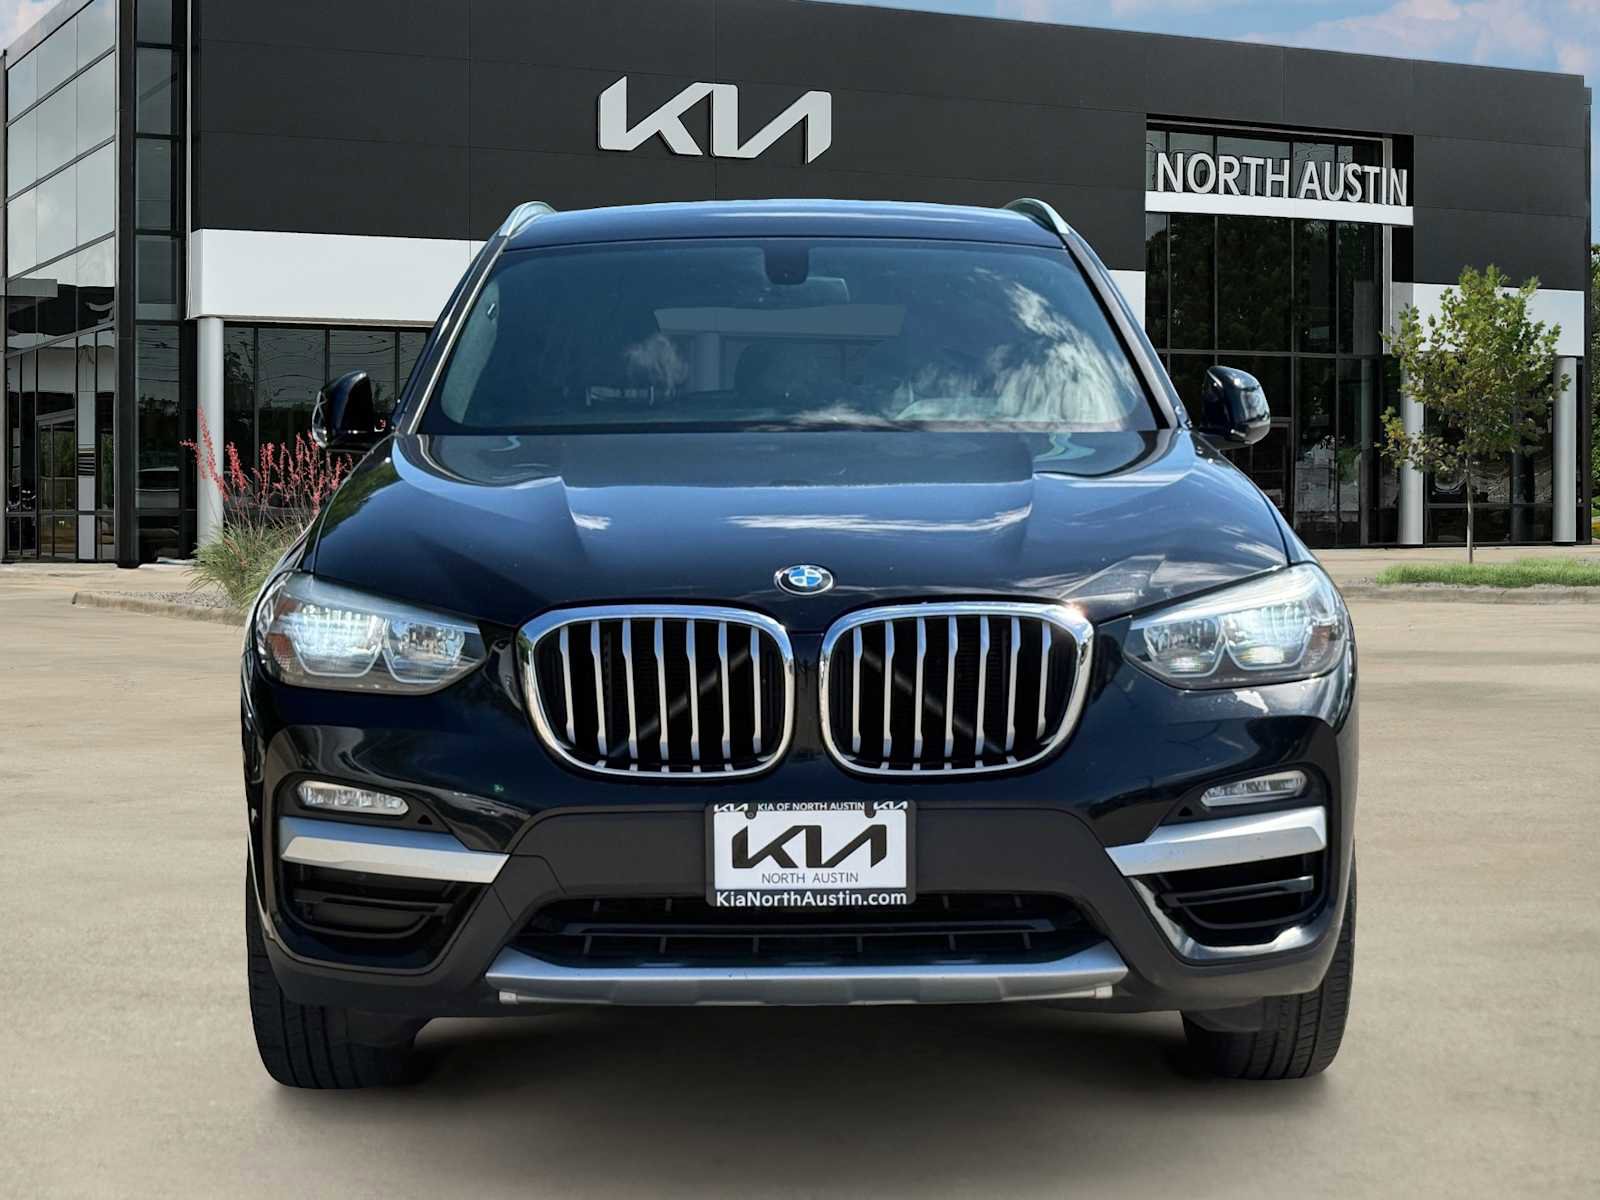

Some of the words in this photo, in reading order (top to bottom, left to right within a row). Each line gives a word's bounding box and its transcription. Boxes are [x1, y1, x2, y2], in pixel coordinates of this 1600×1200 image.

[598, 75, 832, 164] KIA
[1156, 152, 1291, 199] NORTH
[1299, 160, 1408, 206] AUSTIN
[757, 803, 774, 811] KIA
[777, 803, 790, 811] OF
[792, 802, 828, 811] NORTH
[830, 802, 865, 811] AUSTIN
[732, 824, 887, 869] KIA
[761, 872, 806, 884] NORTH
[813, 872, 859, 883] AUSTIN
[716, 891, 907, 907] KiaNorthAustin.com
